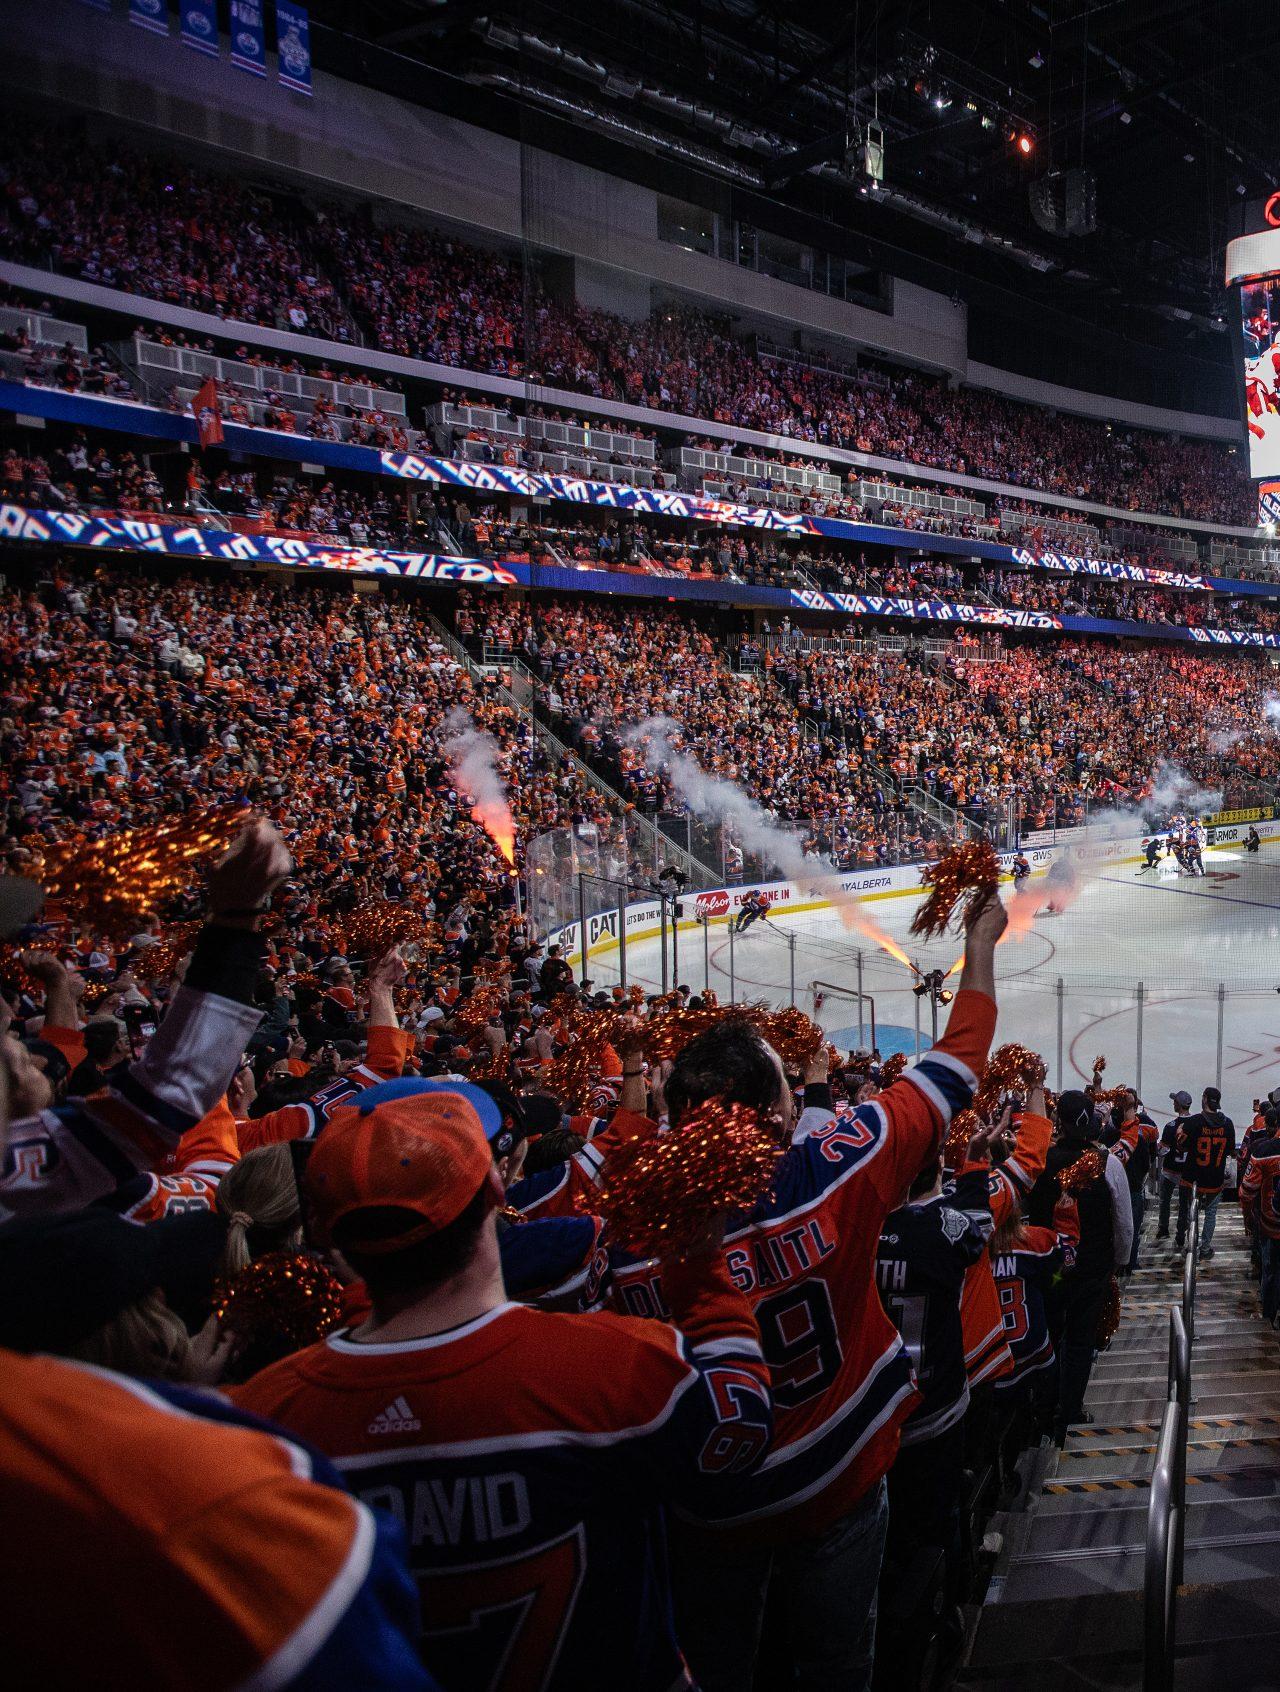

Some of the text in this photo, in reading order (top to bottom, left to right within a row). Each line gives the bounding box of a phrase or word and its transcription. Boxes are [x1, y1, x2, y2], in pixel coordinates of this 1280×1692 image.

[1032, 850, 1053, 863] aws
[781, 889, 790, 899] IN
[695, 894, 730, 917] Molson
[590, 912, 618, 944] CAT
[1195, 1136, 1228, 1168] 97
[367, 1417, 422, 1435] adidas
